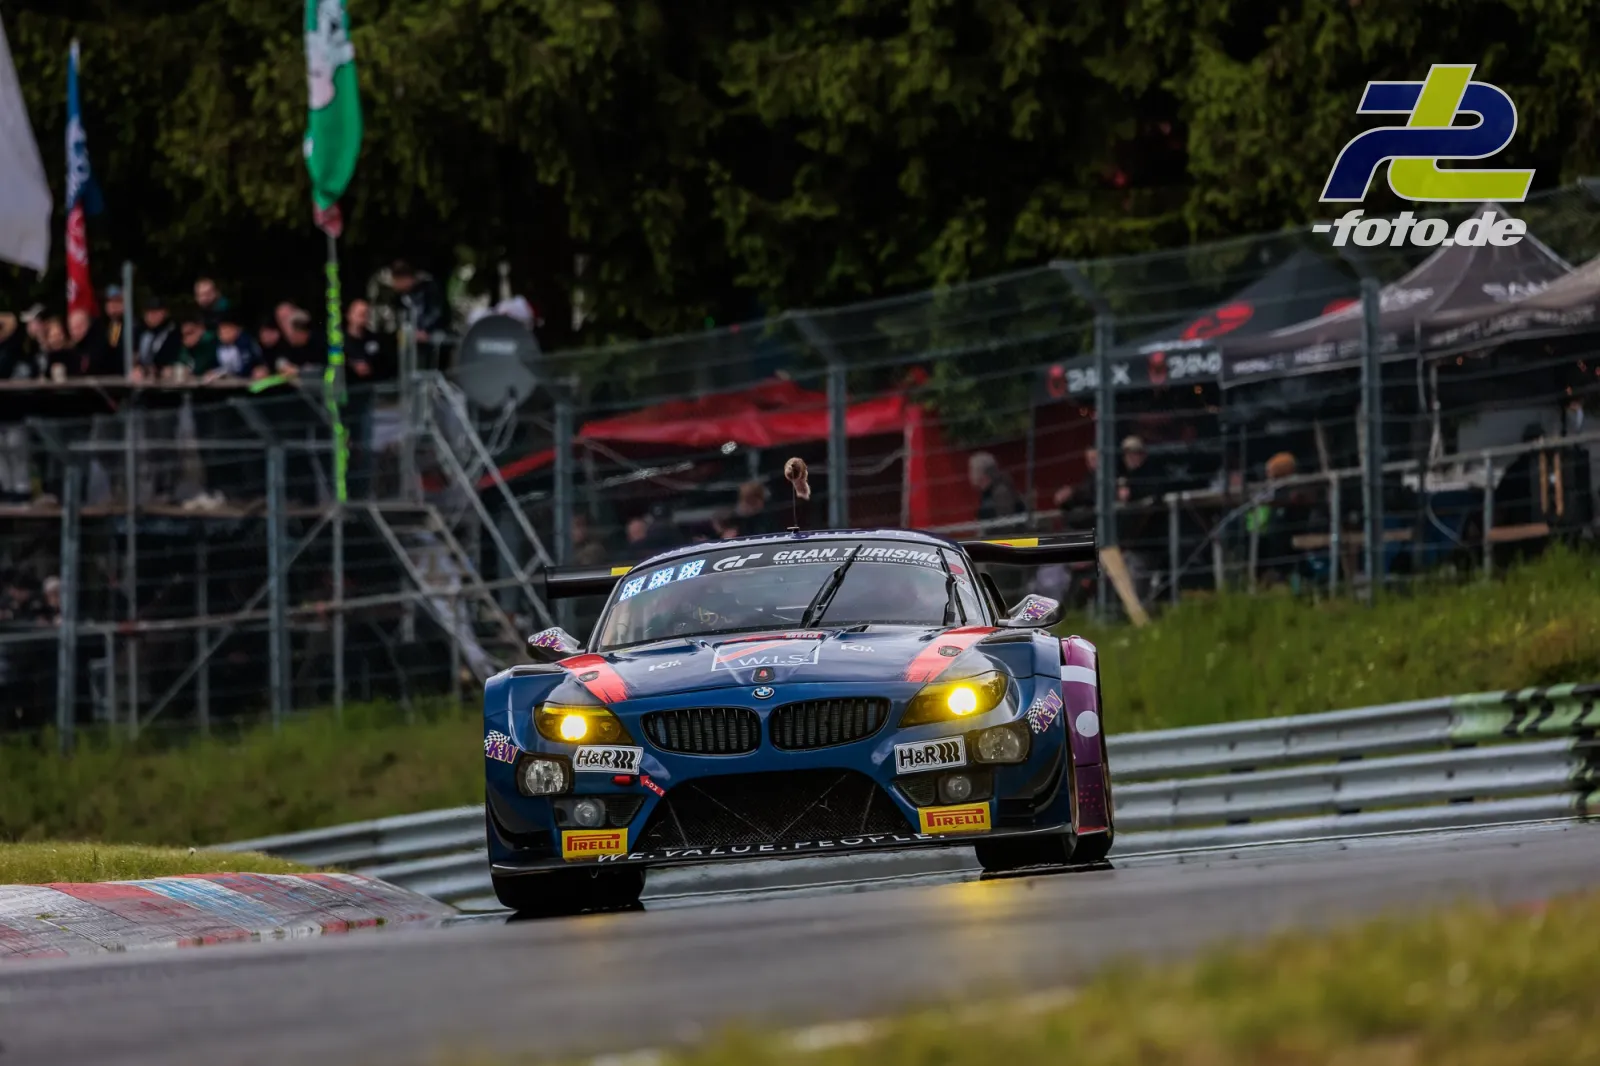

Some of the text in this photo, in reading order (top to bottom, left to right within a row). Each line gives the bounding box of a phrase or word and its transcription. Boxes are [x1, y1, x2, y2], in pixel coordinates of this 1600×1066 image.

[773, 547, 941, 563] GRAN TURISMO
[876, 557, 939, 568] SIMULATOR
[576, 750, 614, 768] H&R
[899, 745, 940, 769] H&R
[926, 808, 985, 828] PIRELLI
[566, 833, 621, 851] PIRELLI
